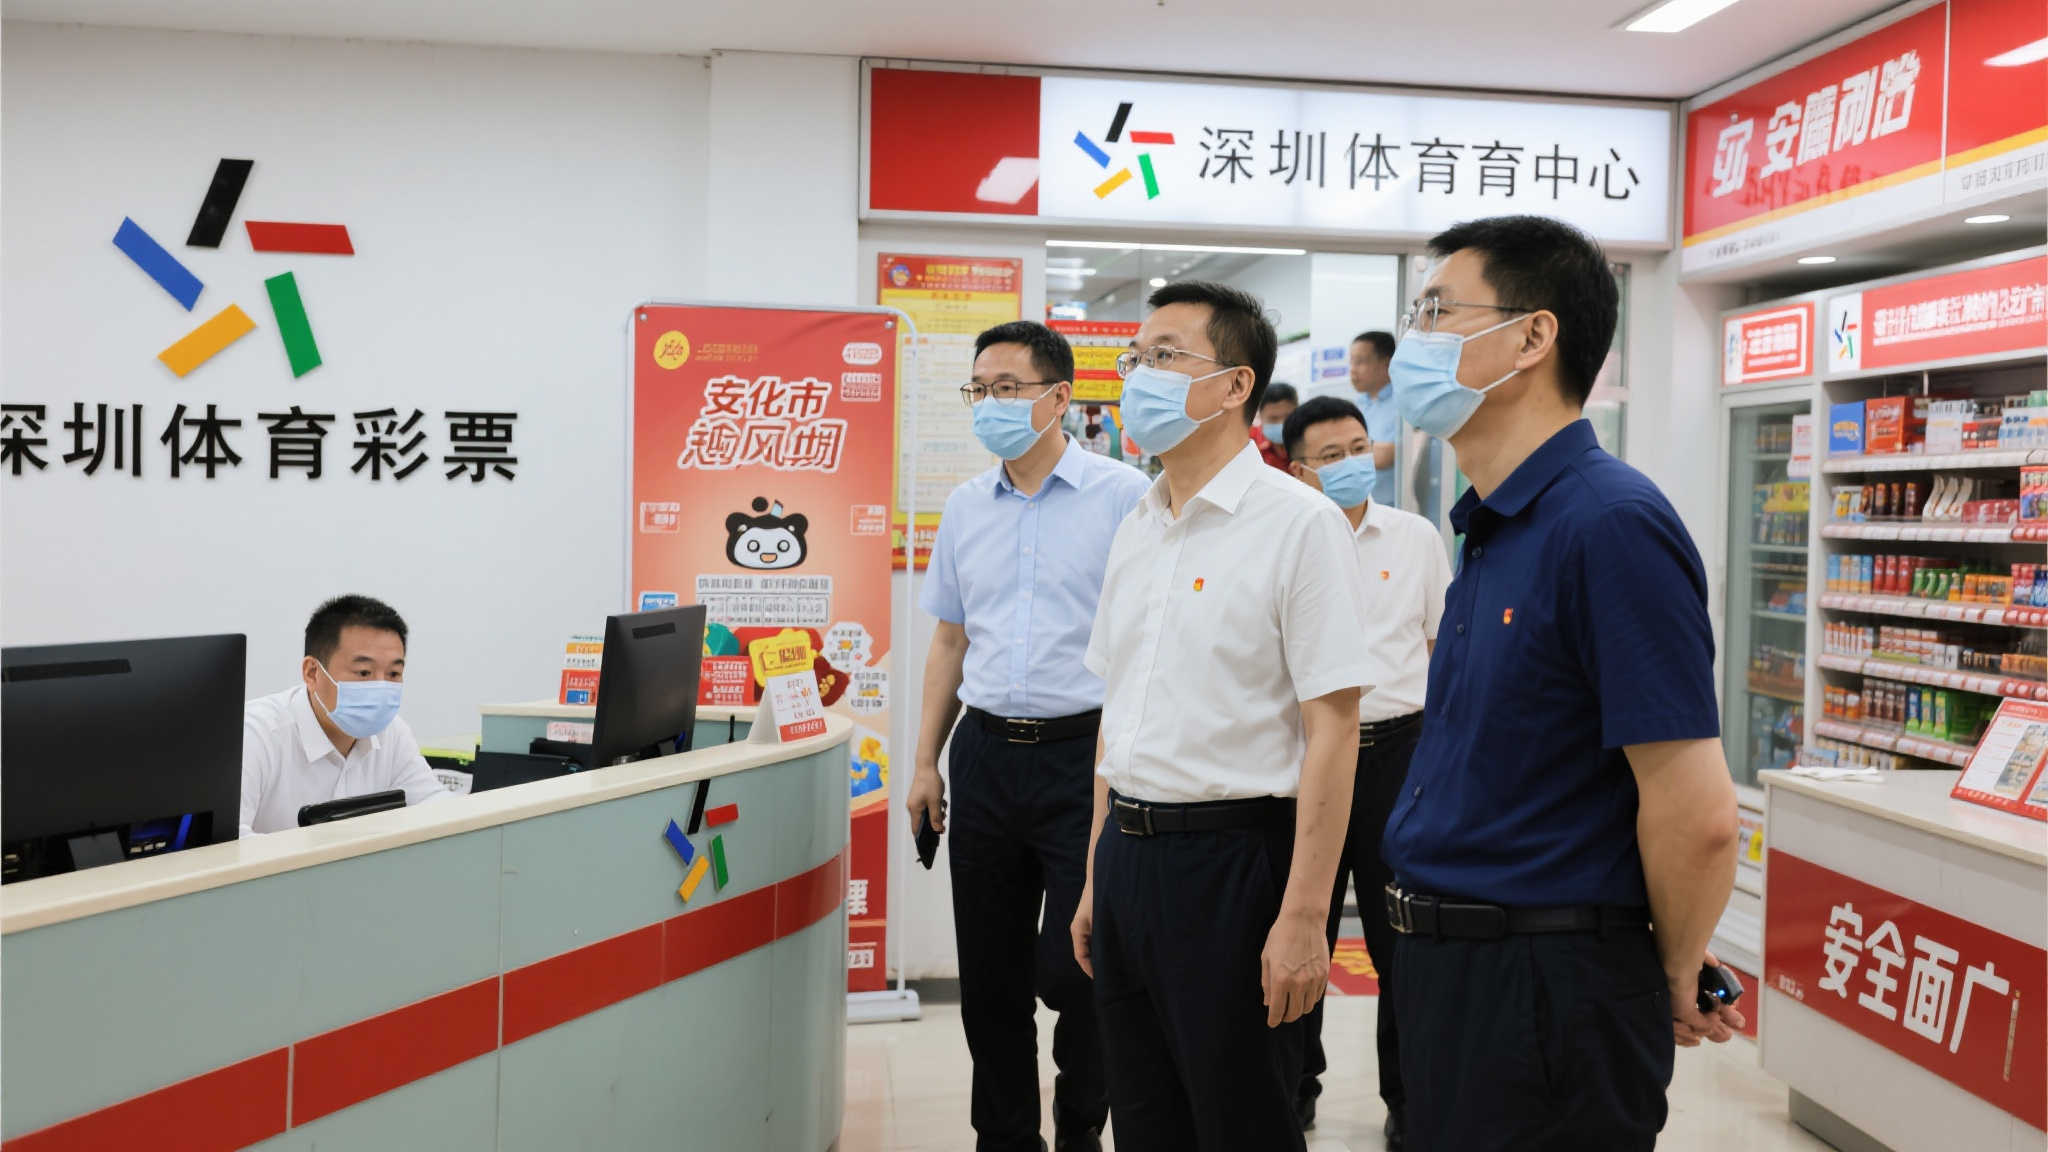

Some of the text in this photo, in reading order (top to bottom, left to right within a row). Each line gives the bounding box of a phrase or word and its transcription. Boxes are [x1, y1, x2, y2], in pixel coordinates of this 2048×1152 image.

[1198, 126, 1641, 201] 深圳体育育中心
